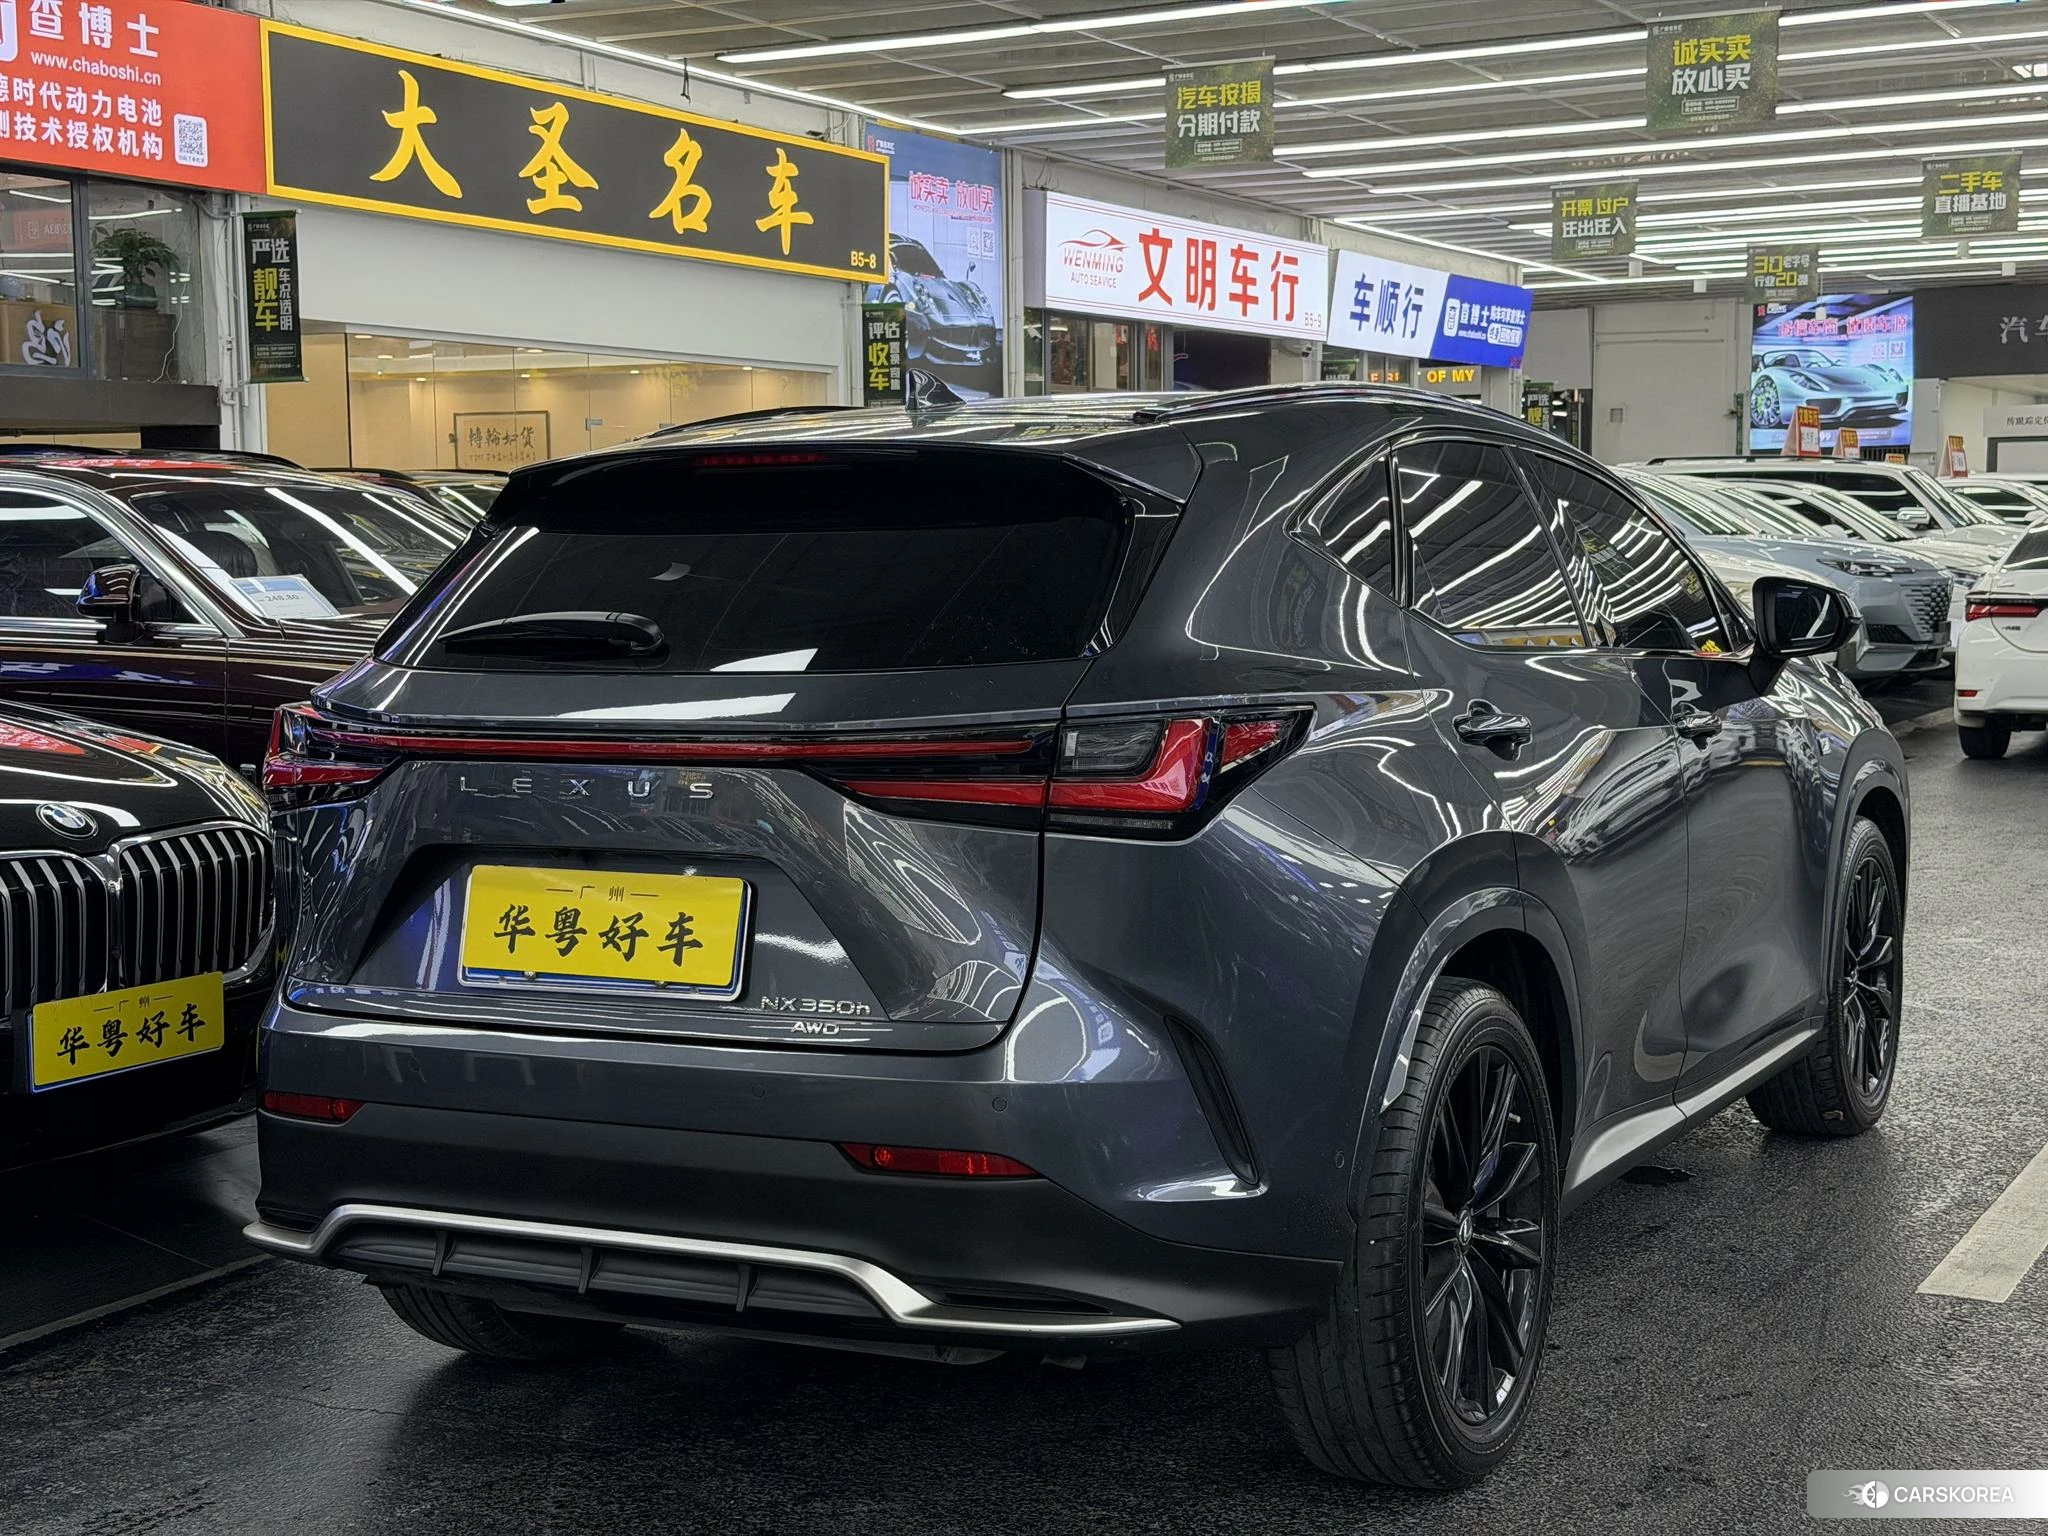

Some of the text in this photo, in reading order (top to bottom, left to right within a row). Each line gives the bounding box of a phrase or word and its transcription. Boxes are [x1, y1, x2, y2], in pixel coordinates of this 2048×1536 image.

[29, 0, 160, 58] 查博士
[30, 50, 161, 86] www.chaboshi.cn
[1671, 62, 1751, 95] 放心买
[1176, 80, 1261, 110] 汽车按揭
[1176, 108, 1261, 138] 分期付款
[369, 69, 814, 256] 大圣名车
[955, 180, 994, 214] 放心买
[1938, 171, 2003, 195] 二手车
[1934, 191, 2007, 214] 直播基地
[251, 237, 290, 264] 严选
[850, 250, 877, 269] B5-8
[1063, 247, 1124, 273] WENMING
[1138, 227, 1299, 322] 文明车行
[253, 267, 279, 332] 靓车
[1349, 273, 1425, 340] 车顺行
[868, 321, 901, 340] 评估
[868, 341, 890, 391] 收车
[1426, 368, 1475, 383] OF MY
[460, 775, 714, 800] LEXUS
[577, 884, 626, 903] 广州
[493, 903, 704, 967] 华粤好车
[760, 996, 871, 1016] NX350h
[56, 1002, 206, 1066] 华粤好车
[790, 1021, 841, 1036] AWD
